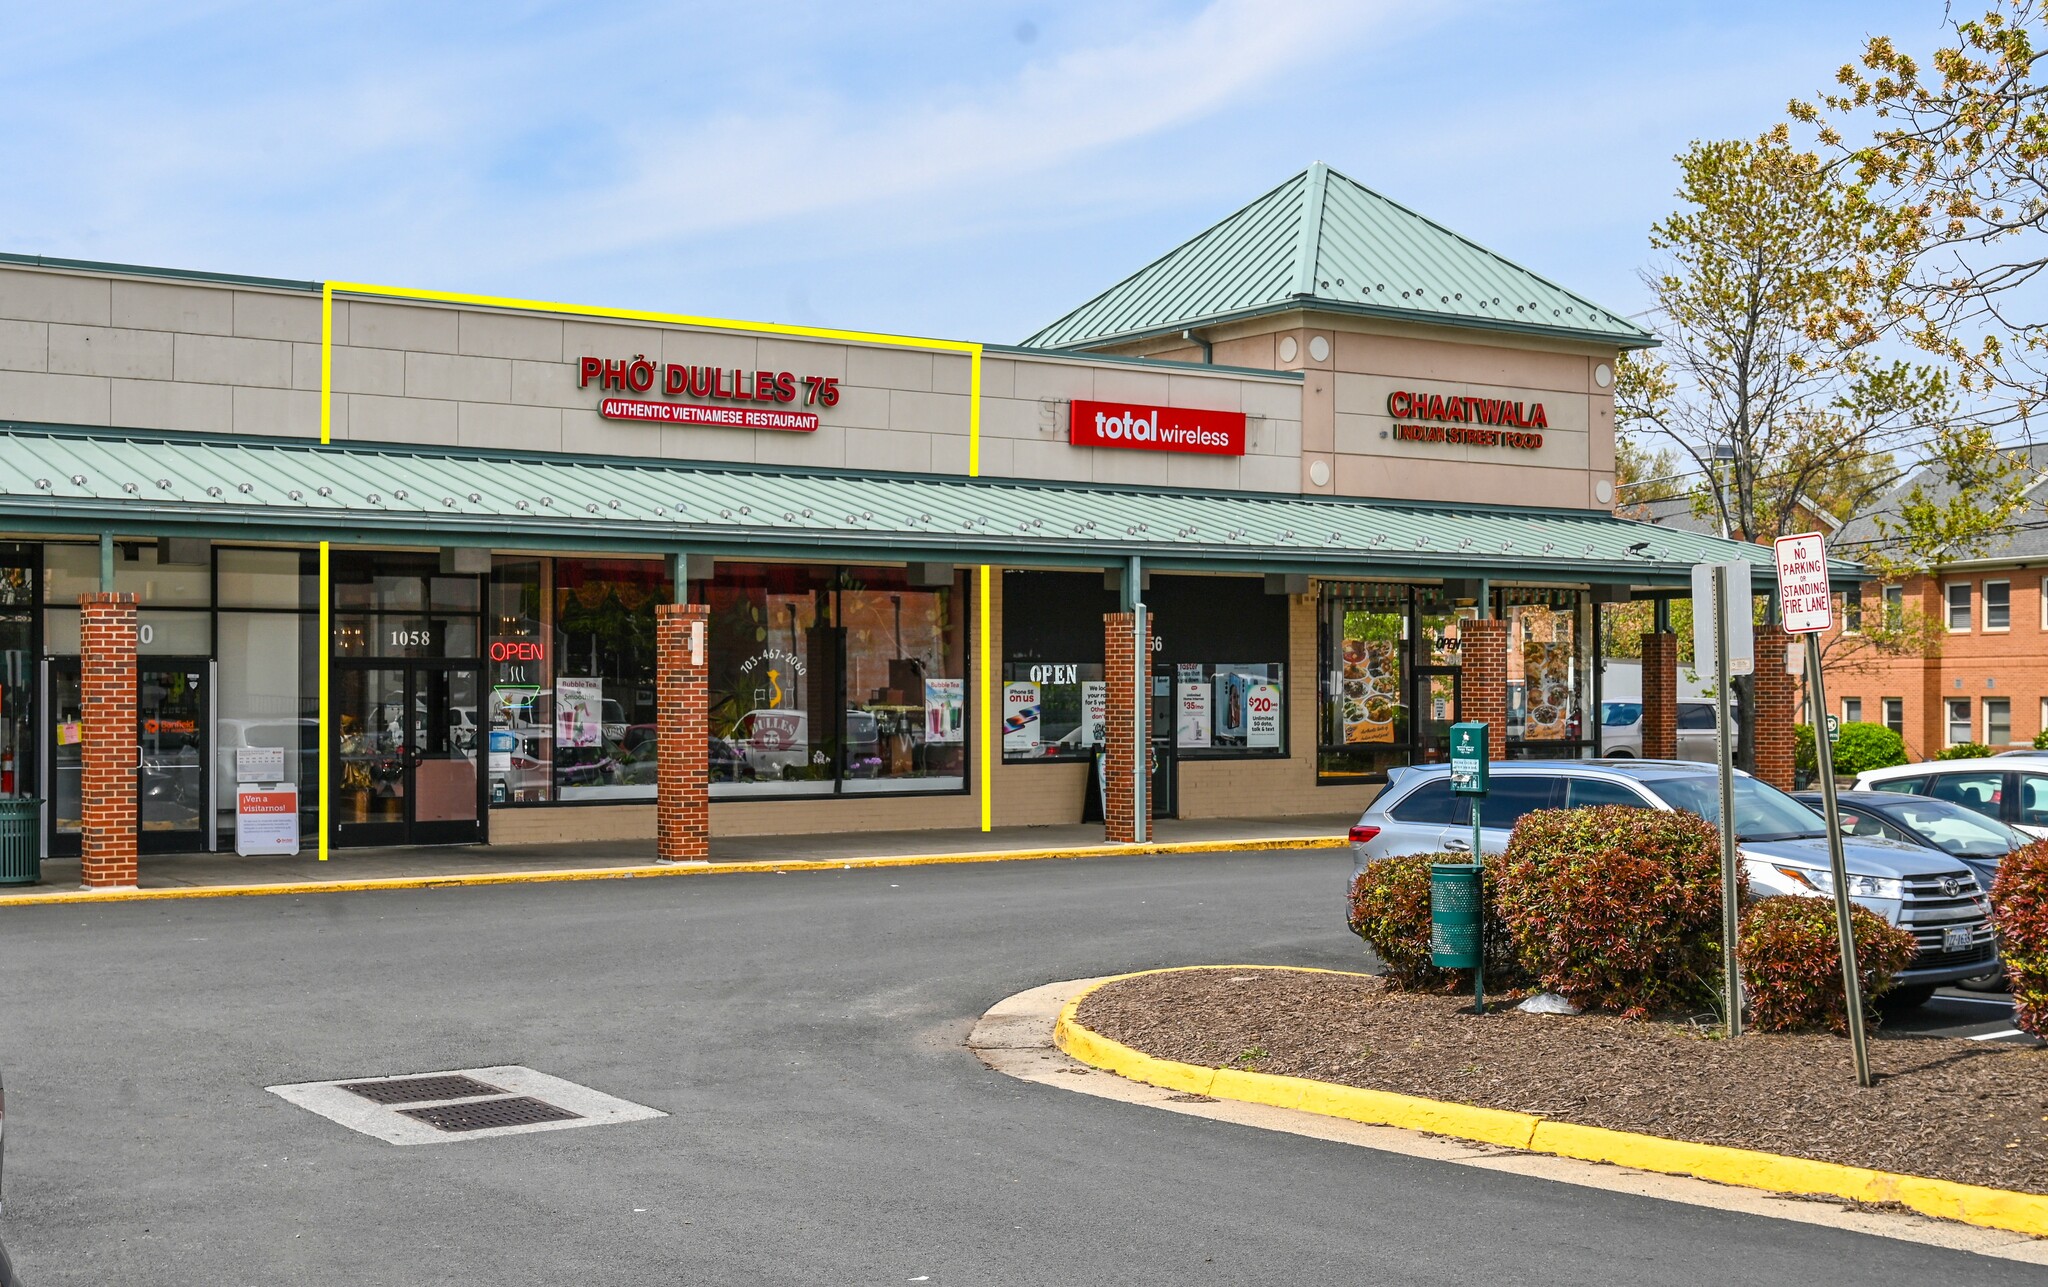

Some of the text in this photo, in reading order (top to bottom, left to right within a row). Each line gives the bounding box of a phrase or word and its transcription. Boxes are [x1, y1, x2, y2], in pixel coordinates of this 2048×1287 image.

[662, 363, 796, 403] DULLES
[801, 375, 840, 407] 75
[605, 401, 817, 429] AUTHENTIC VIETNAMESE RESTAURANT
[1387, 391, 1548, 428] CHAATWALA
[1095, 410, 1229, 447] total wireless
[1393, 424, 1543, 449] INDIAN STREET FOOD
[1793, 547, 1807, 560] NO
[1783, 560, 1821, 576] PARKING
[1783, 581, 1826, 598] STANDING
[1785, 596, 1828, 615] FIRE LANE
[136, 624, 153, 644] 0
[391, 630, 431, 646] 1058
[490, 642, 544, 661] OPEN
[1150, 636, 1163, 651] 56
[1435, 637, 1462, 650] OPEN
[1029, 664, 1078, 685] OPEN
[1023, 695, 1034, 703] us
[1249, 696, 1271, 712] $20
[752, 717, 796, 736] DULLES
[764, 734, 779, 744] 75
[243, 795, 261, 804] ¡Ven
[243, 804, 286, 812] visitarnos!
